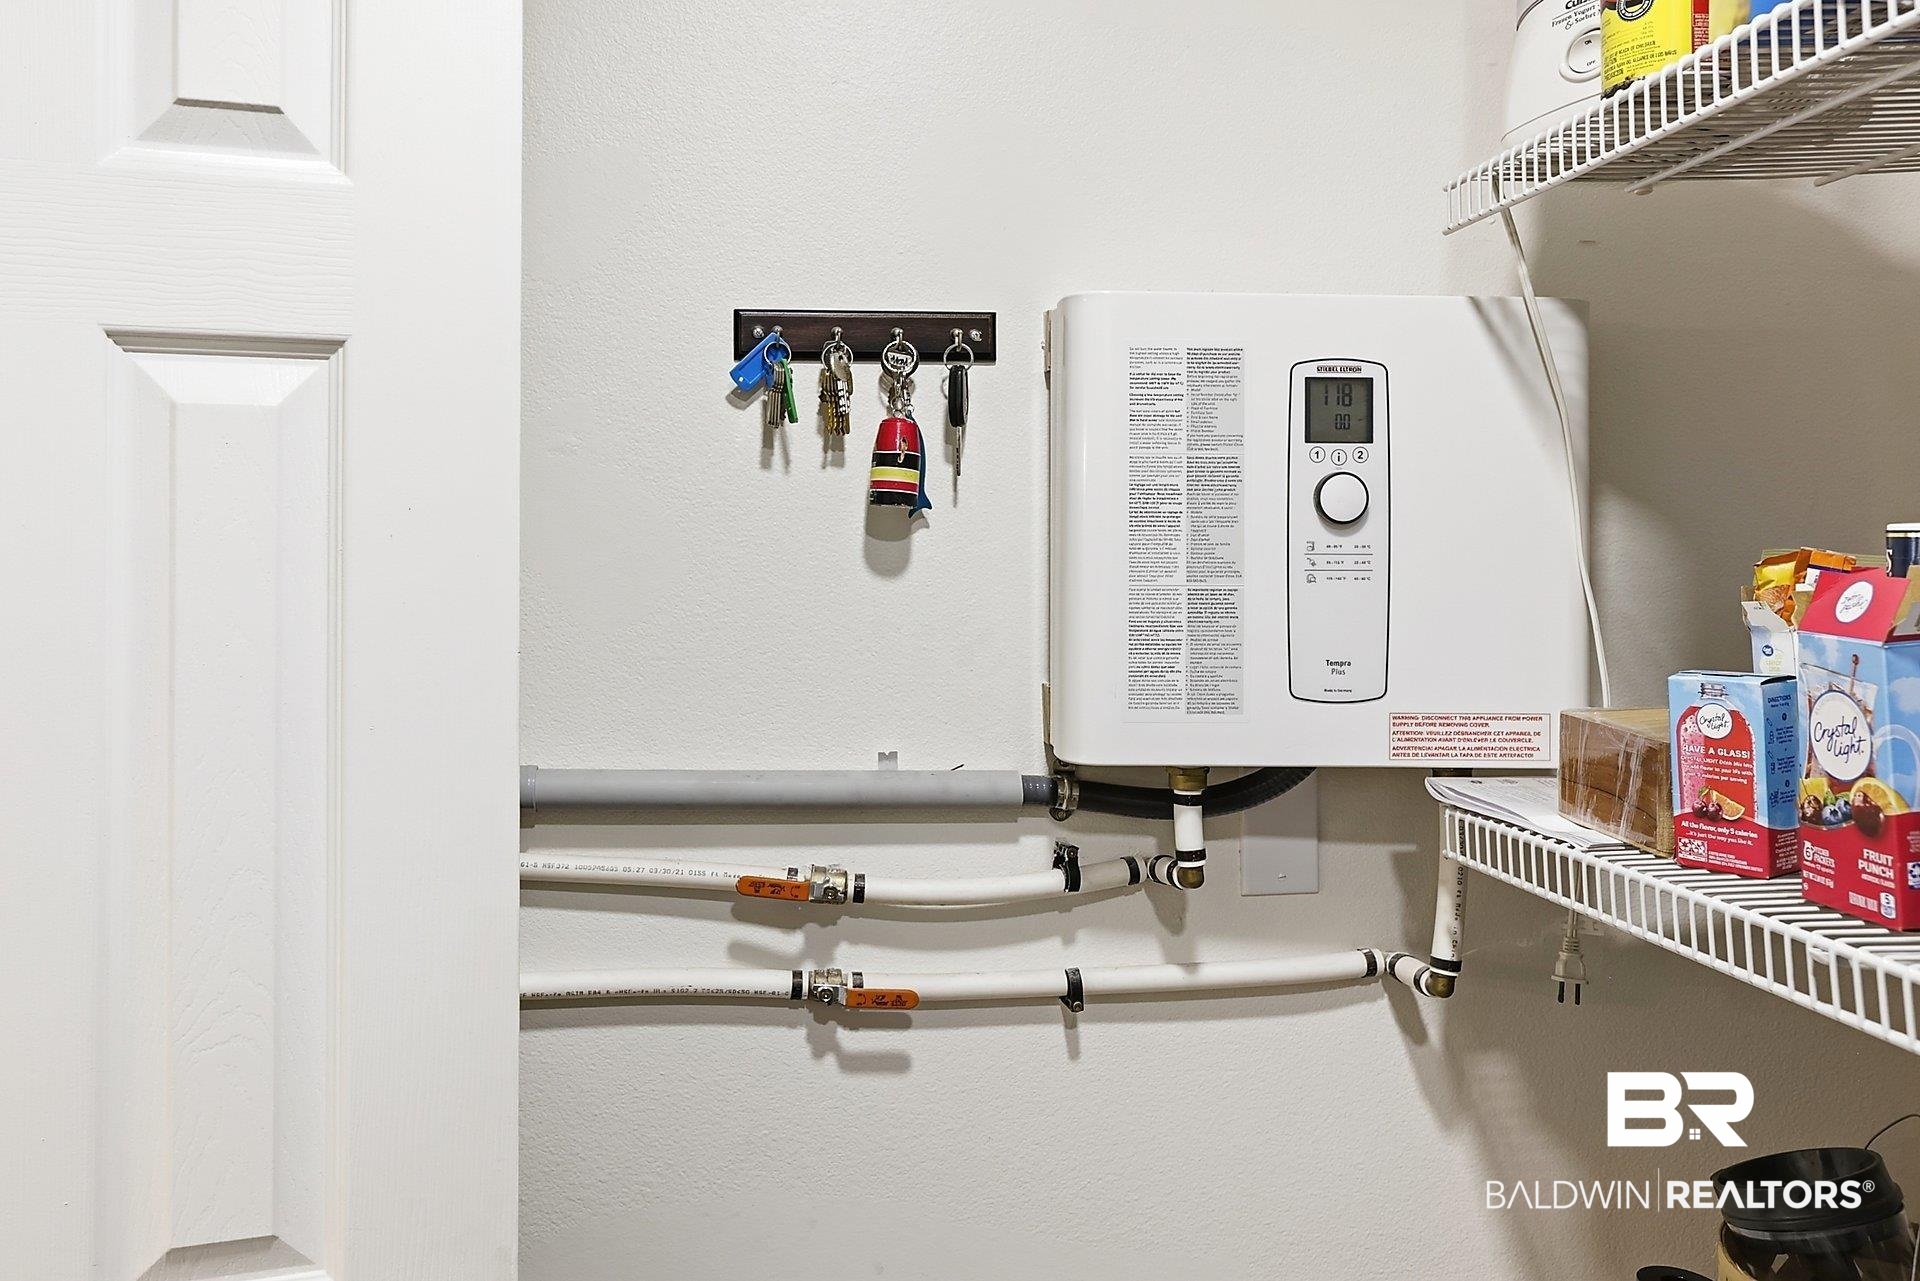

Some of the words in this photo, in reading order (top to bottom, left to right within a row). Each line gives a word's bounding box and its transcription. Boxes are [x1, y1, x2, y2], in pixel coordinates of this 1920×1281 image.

[1574, 4, 1596, 16] Yogurt
[1574, 12, 1596, 24] Sorbet
[1357, 451, 1363, 459] 2
[1326, 660, 1351, 668] Tempra
[1700, 713, 1726, 730] Crystal
[1814, 716, 1858, 751] Crystal
[1682, 745, 1705, 754] HAVE
[1718, 748, 1750, 759] GLASS!
[1717, 826, 1729, 835] only
[1863, 848, 1894, 866] FRUIT
[1858, 858, 1894, 880] PUNCH
